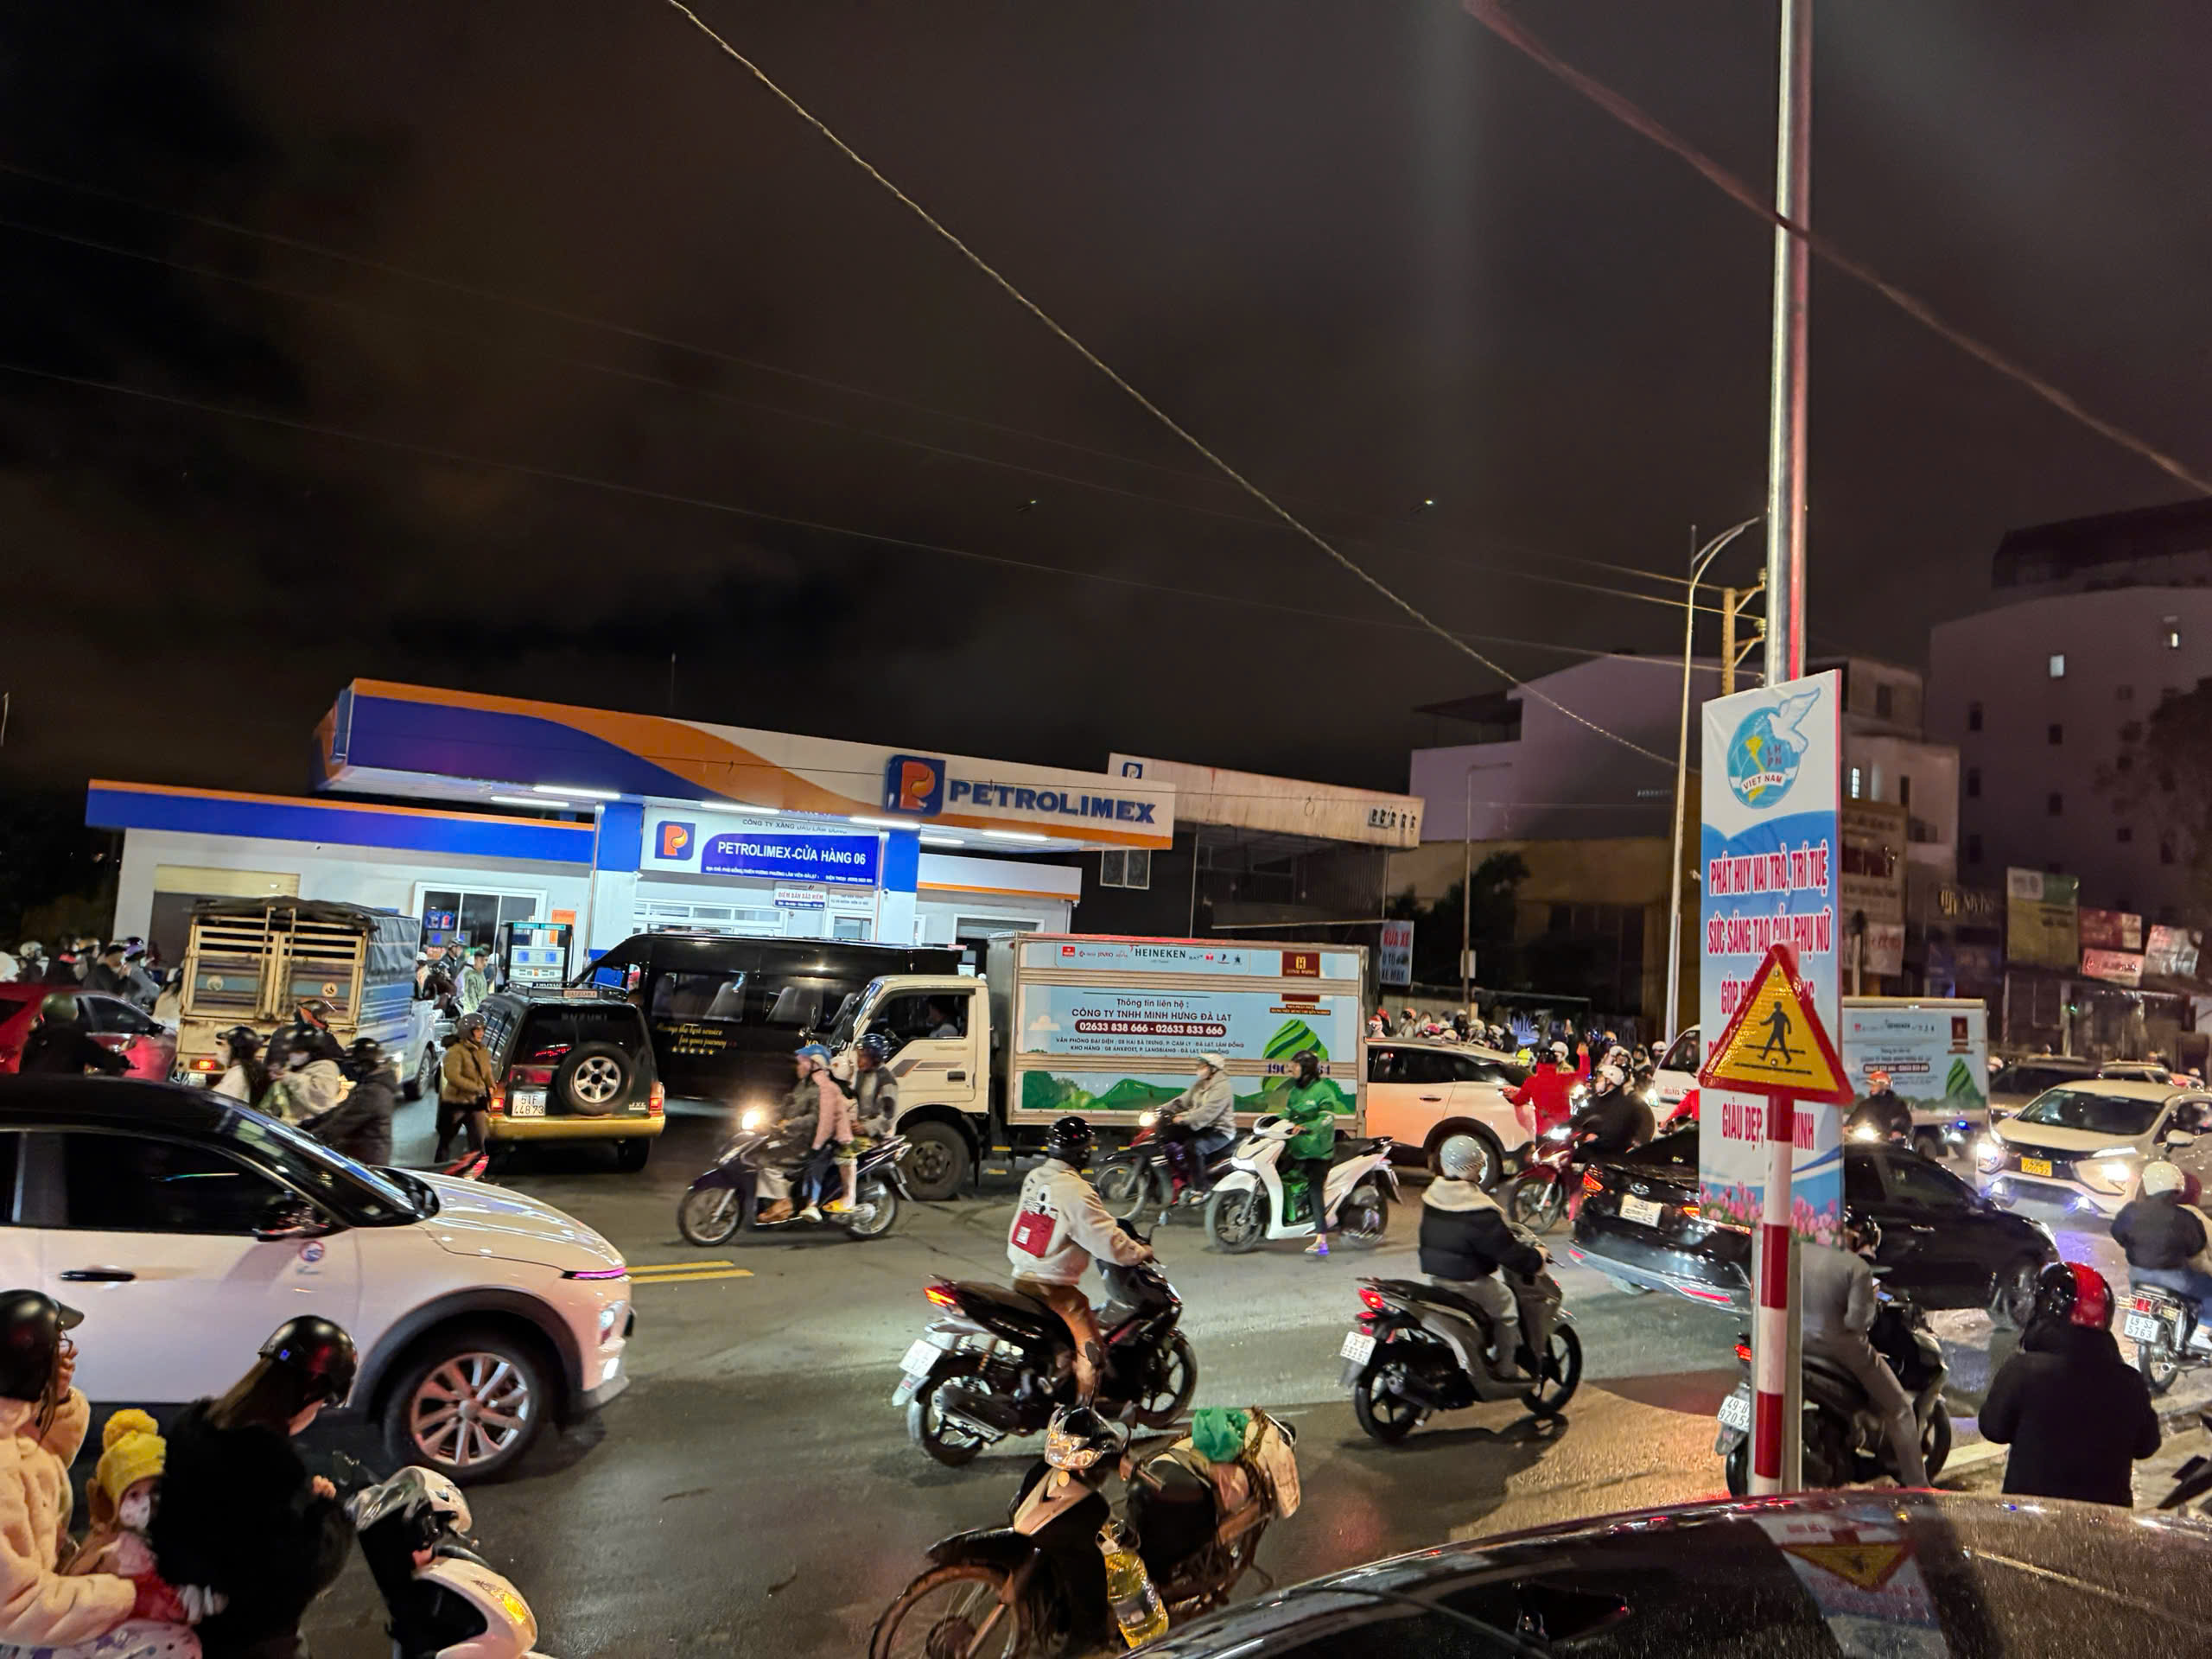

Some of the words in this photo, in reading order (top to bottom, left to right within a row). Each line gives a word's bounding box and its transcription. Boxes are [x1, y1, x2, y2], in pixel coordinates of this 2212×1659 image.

[1764, 774, 1783, 784] NAM
[949, 779, 1155, 824] PETROLIMEX
[742, 818, 763, 827] CÔNG
[821, 847, 851, 864] HÀNG
[854, 853, 866, 865] 06
[1710, 852, 1732, 895] PHÁT
[1734, 858, 1751, 893] HUY
[1753, 856, 1767, 892] VAI
[1792, 842, 1807, 889] TRÍ
[1809, 841, 1827, 895] TUỆ
[1708, 912, 1725, 954] SỨC
[1727, 912, 1751, 954] SÁNG
[1754, 918, 1770, 961] TẠO
[1816, 907, 1832, 952] NỮ
[1135, 948, 1185, 958] HEINEKEN
[1117, 998, 1141, 1008] Thông
[1174, 1000, 1184, 1009] hệ
[1071, 1007, 1101, 1017] CÔNG
[1103, 1009, 1114, 1018] TY
[1117, 1010, 1141, 1019] TNHH
[1144, 1011, 1168, 1020] MINH
[1171, 1012, 1198, 1020] HƯNG
[1201, 1012, 1213, 1021] ĐÀ
[1217, 1014, 1231, 1023] LẠT
[1079, 1021, 1109, 1031] 02633
[1111, 1022, 1128, 1032] 838
[1130, 1023, 1148, 1033] 666
[1155, 1024, 1184, 1033] 02633
[1186, 1025, 1204, 1034] 833
[1205, 1026, 1224, 1035] 666
[521, 1095, 538, 1104] 51F
[1722, 1096, 1743, 1141] GIÀU
